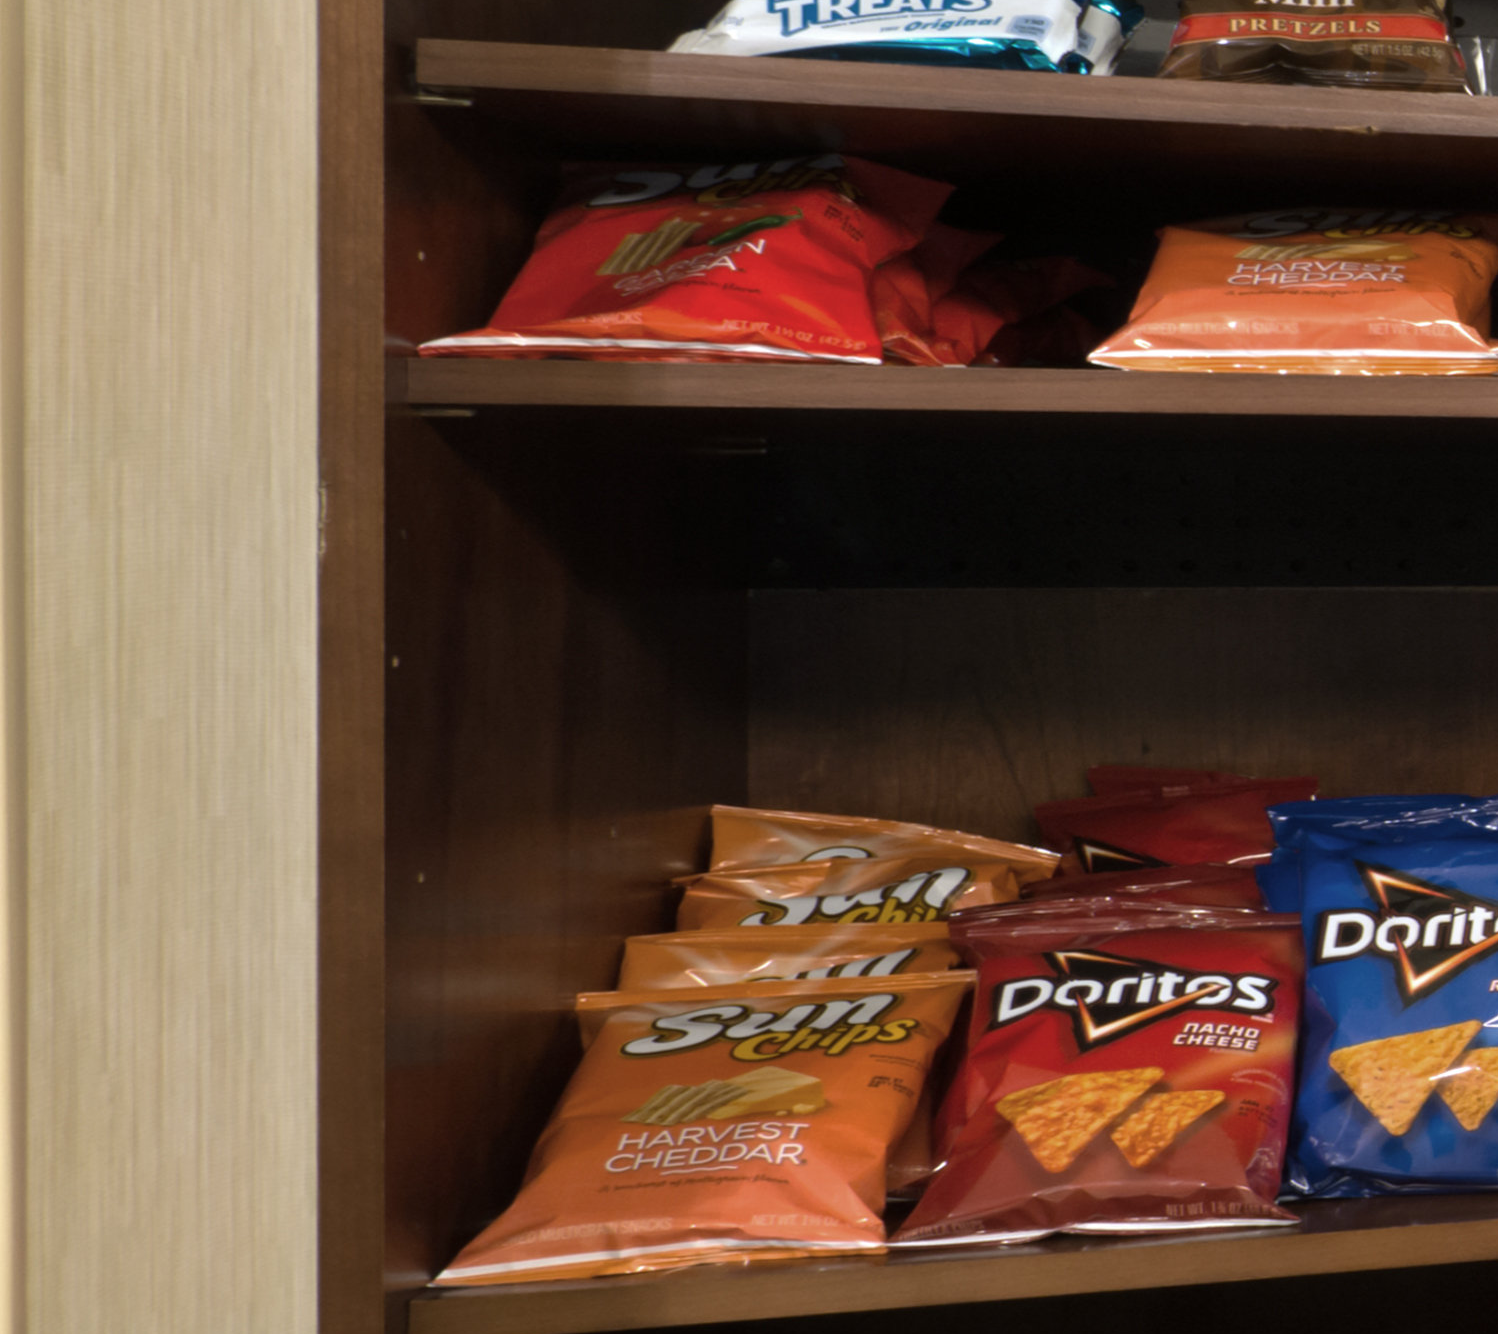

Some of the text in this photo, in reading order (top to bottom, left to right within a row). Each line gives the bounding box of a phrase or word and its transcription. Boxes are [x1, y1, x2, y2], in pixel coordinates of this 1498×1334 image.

[904, 16, 1003, 33] Original
[1229, 18, 1382, 36] PRETZELS
[996, 971, 1277, 1024] Doritos
[620, 992, 902, 1057] Sun
[730, 1017, 919, 1062] Chips
[1183, 1022, 1261, 1039] NACHO
[1172, 1033, 1259, 1052] CHEESE
[616, 1121, 811, 1152] HARVEST
[604, 1143, 809, 1174] CHEDDAR
